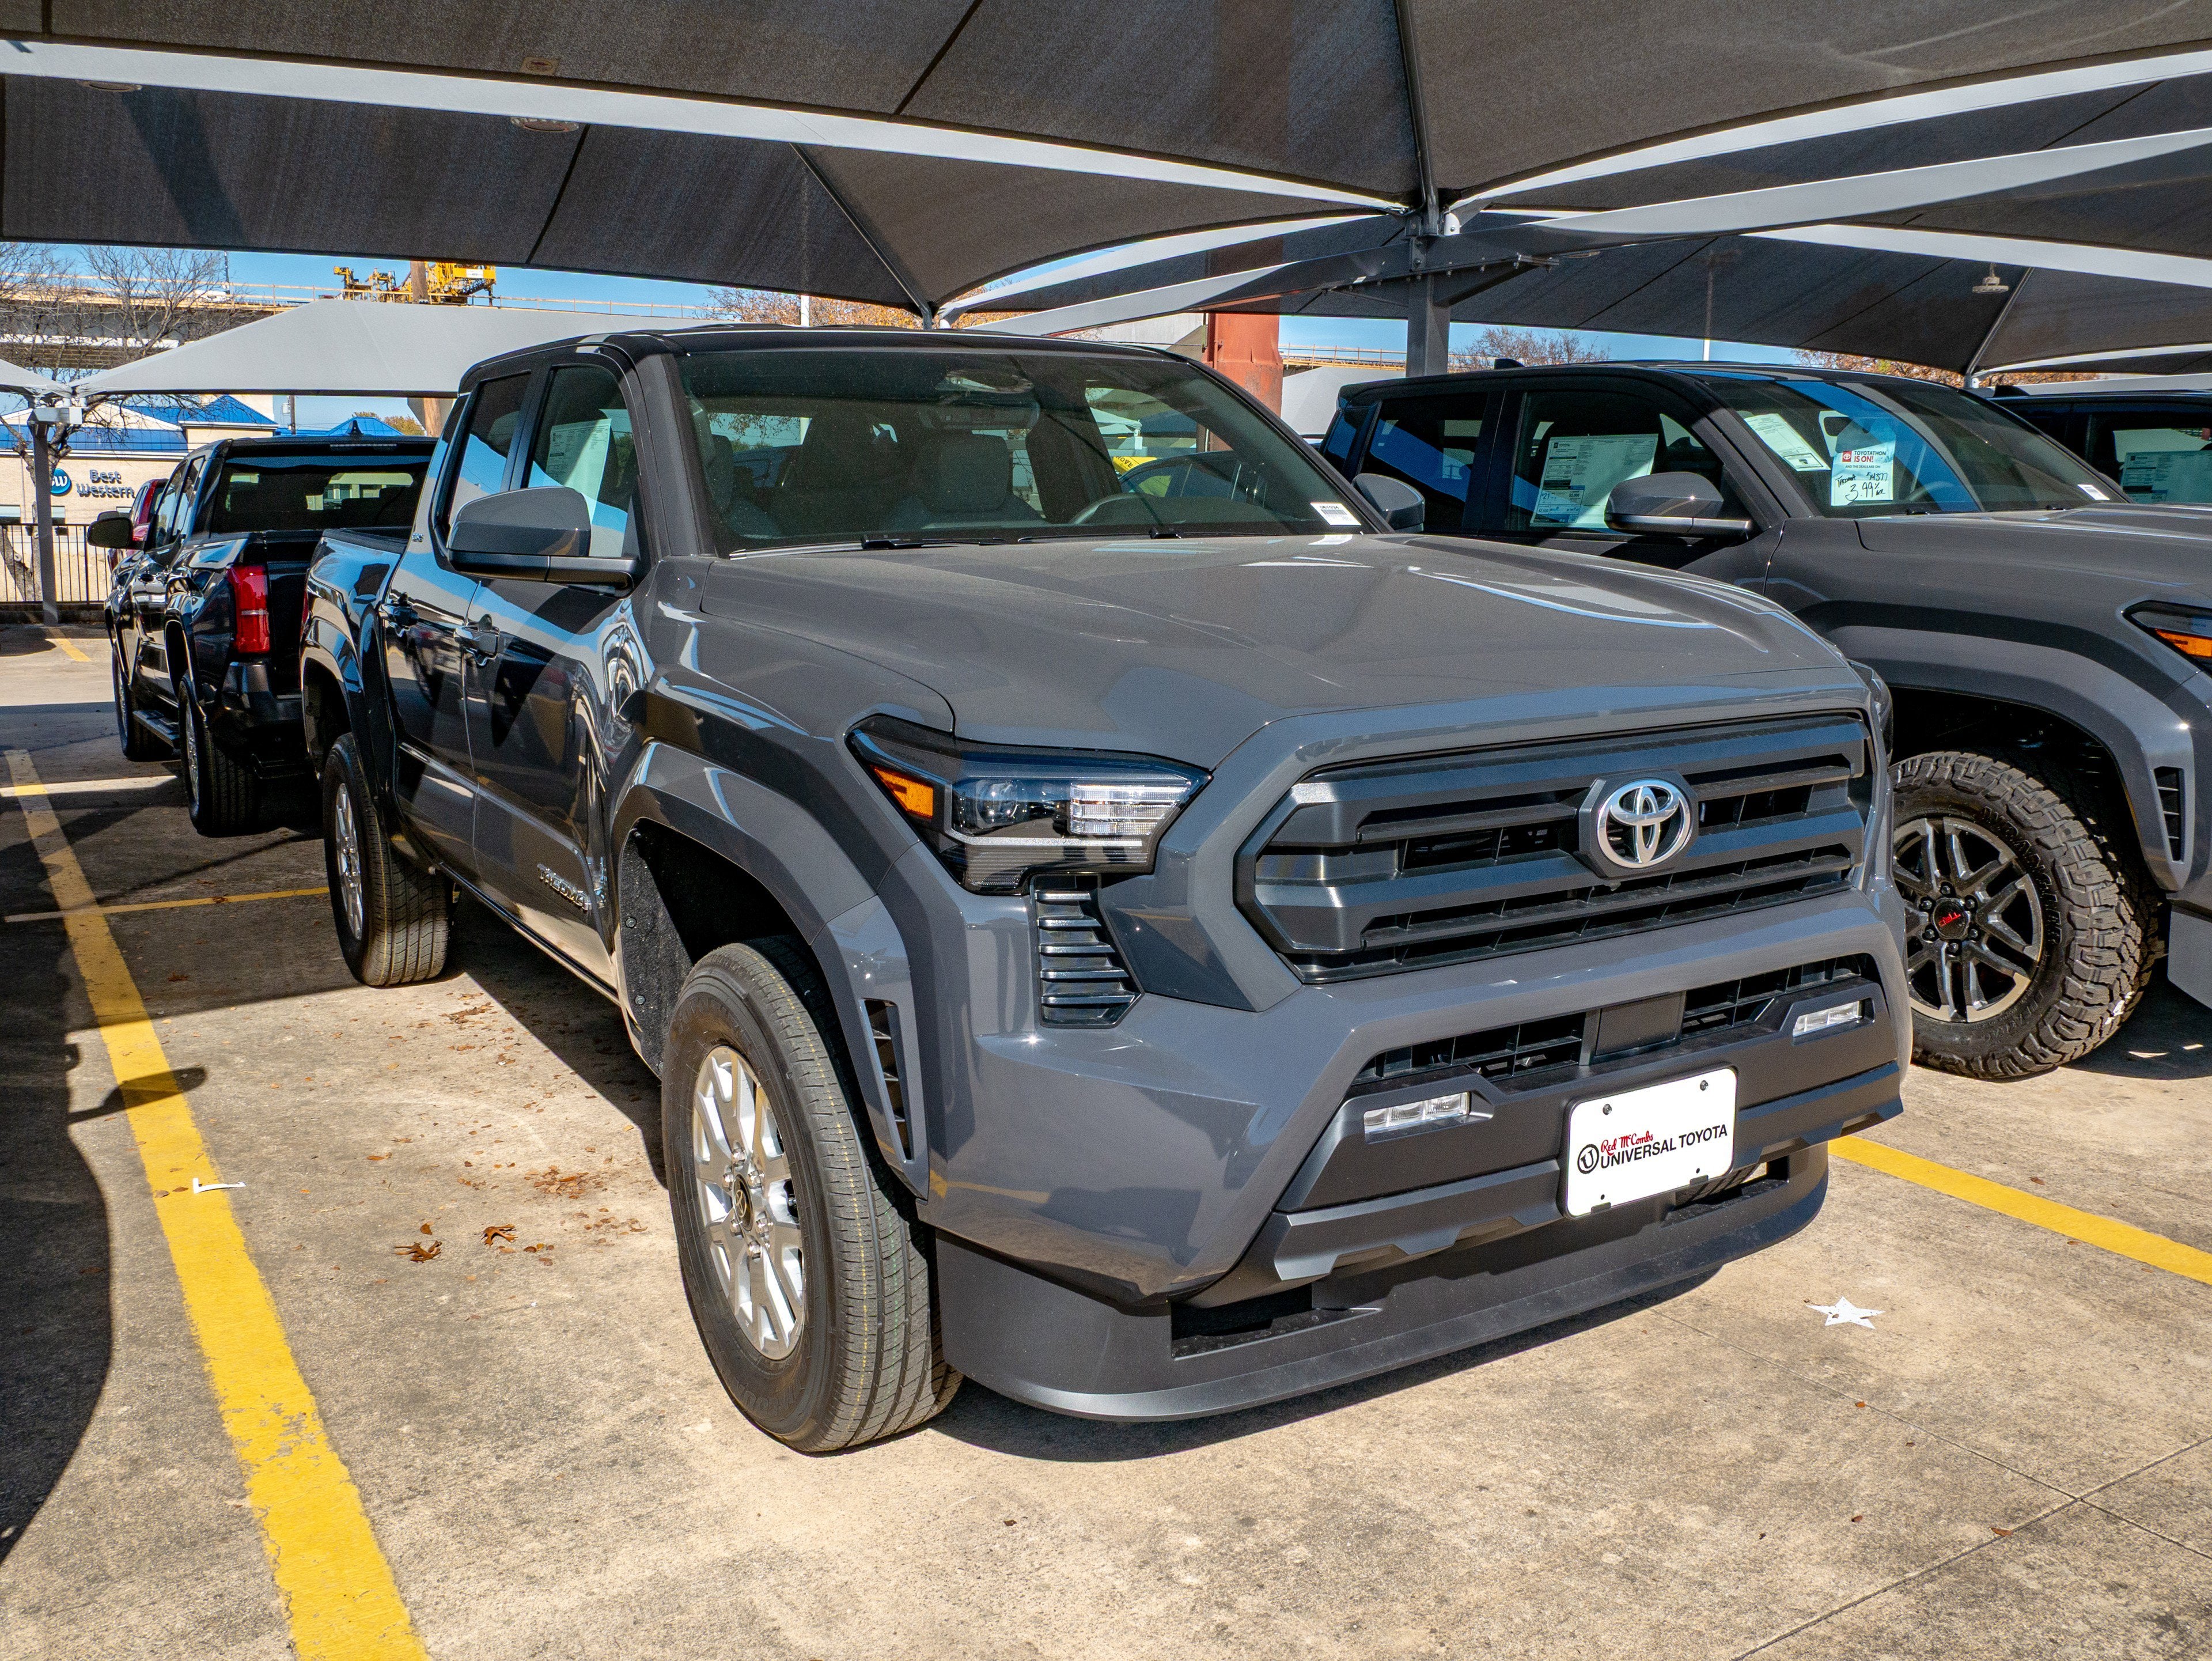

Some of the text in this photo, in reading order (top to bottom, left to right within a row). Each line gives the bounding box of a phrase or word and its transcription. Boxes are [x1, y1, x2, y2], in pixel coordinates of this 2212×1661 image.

[89, 469, 122, 484] Best
[76, 483, 135, 498] Western
[1600, 1130, 1654, 1156] Red McCombs
[1600, 1124, 1728, 1169] UNIVERSAL TOYOTA
